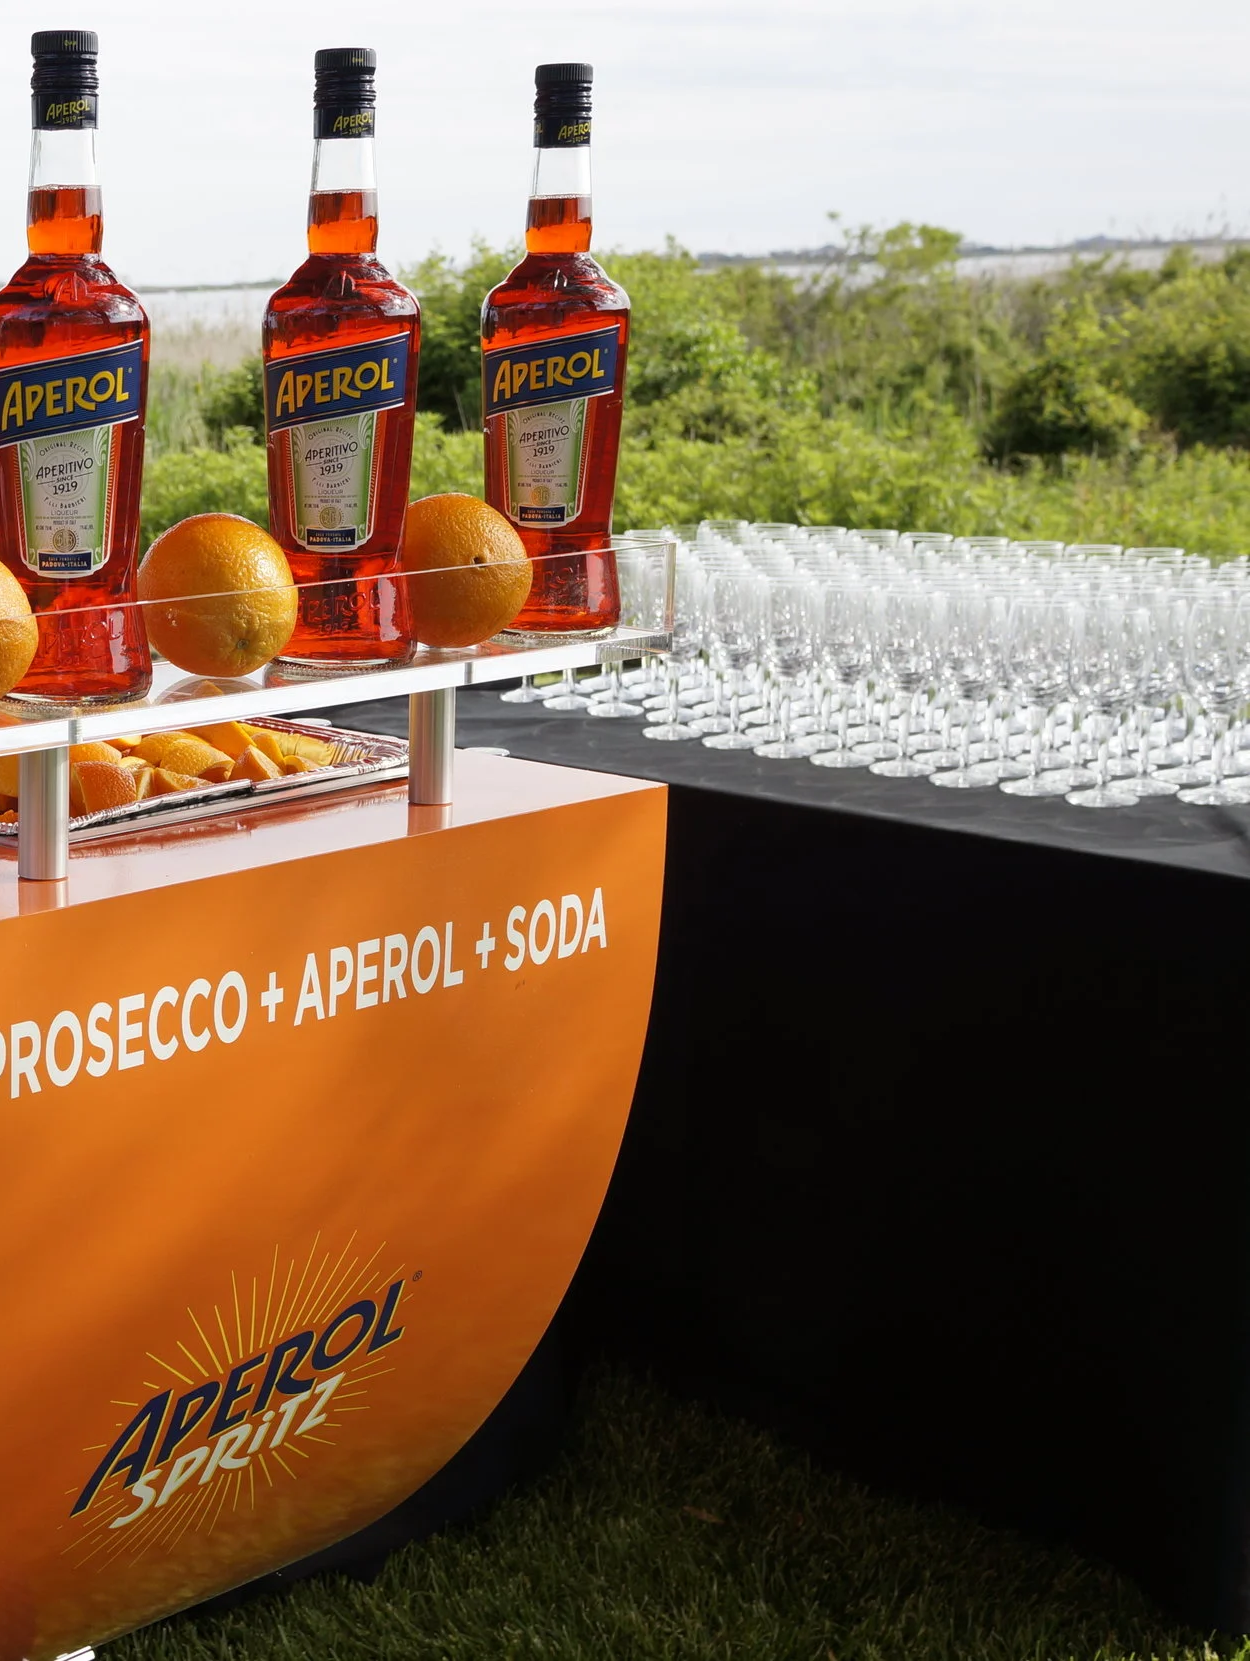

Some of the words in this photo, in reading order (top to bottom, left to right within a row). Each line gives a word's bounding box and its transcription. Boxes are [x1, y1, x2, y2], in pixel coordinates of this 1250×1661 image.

[46, 99, 90, 121] APEROL
[333, 112, 372, 132] APEROL
[493, 348, 605, 403] APEROL
[275, 358, 394, 417] APEROL
[1, 367, 130, 431] APEROL
[520, 425, 569, 444] APERITIVO
[305, 441, 358, 461] APERITIVO
[533, 445, 555, 457] 1919
[36, 458, 93, 479] APERITIVO
[320, 463, 343, 475] 1919
[53, 481, 78, 495] 1919
[260, 972, 284, 1023] +
[293, 921, 464, 1026] APEROL
[475, 921, 495, 970] +
[503, 887, 606, 971] SODA
[69, 1279, 406, 1518] APEROL
